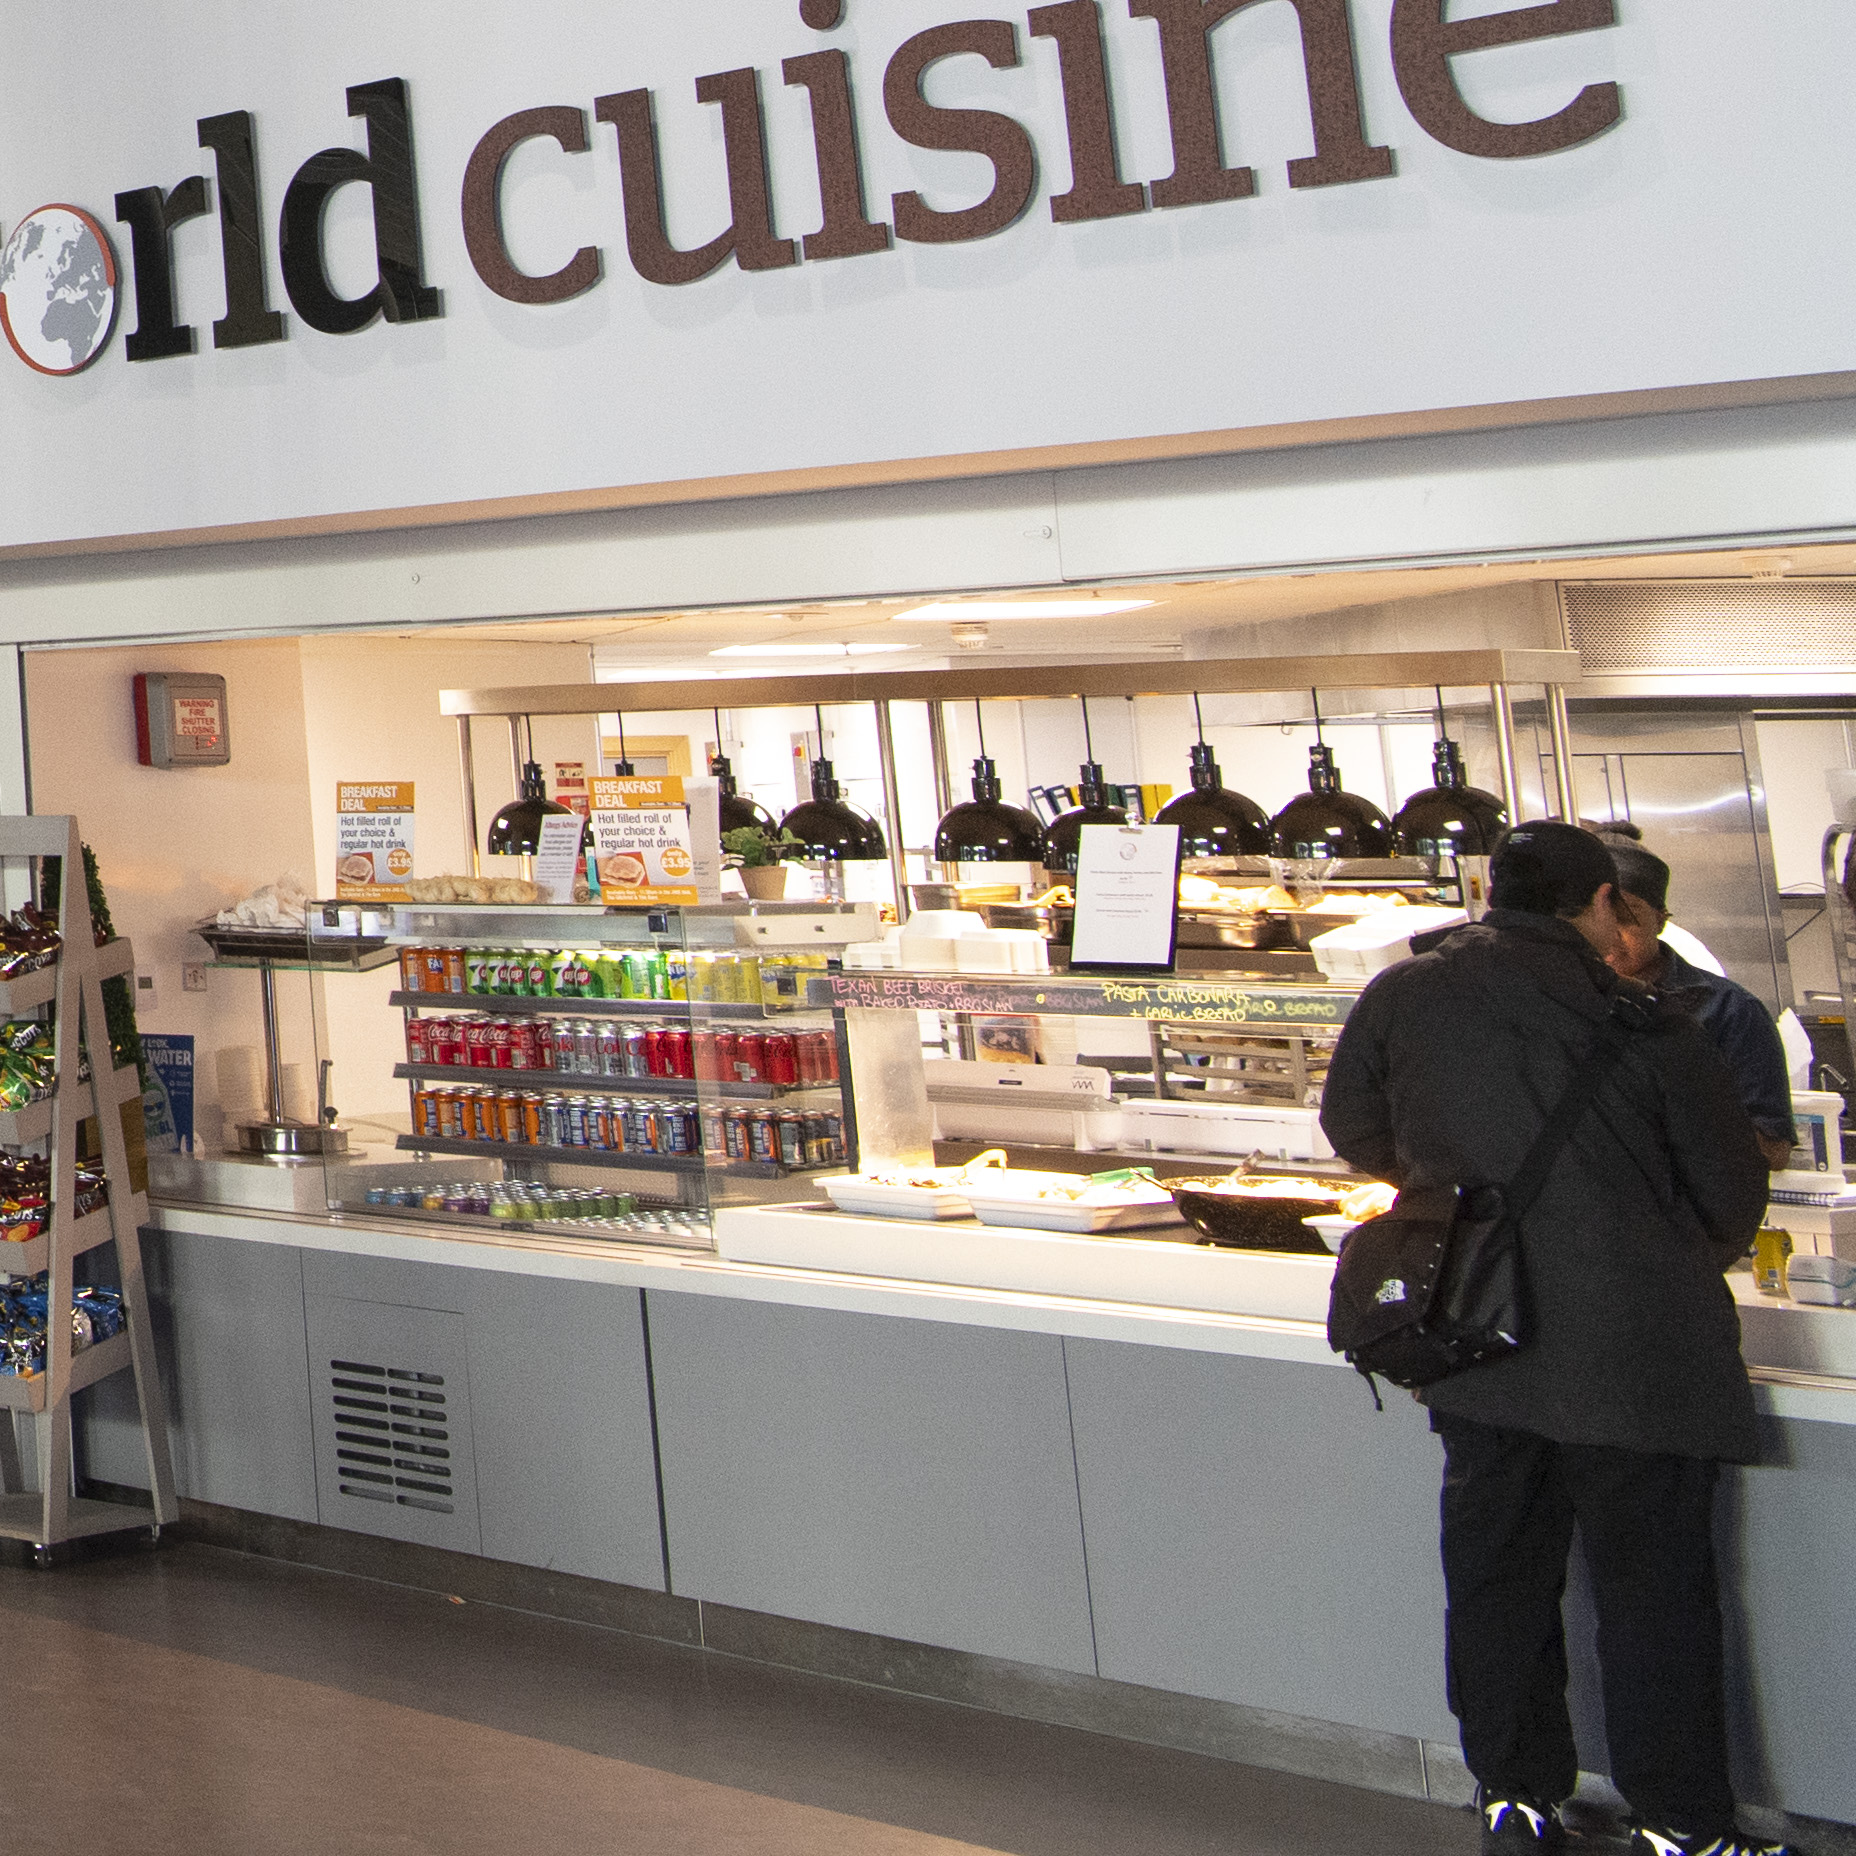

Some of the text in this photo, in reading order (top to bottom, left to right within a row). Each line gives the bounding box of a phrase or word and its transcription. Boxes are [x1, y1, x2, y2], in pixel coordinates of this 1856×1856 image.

[179, 700, 214, 708] WARNING
[181, 717, 215, 725] SHUTTER
[182, 726, 215, 734] CLOSING
[340, 786, 398, 798] BREAKFAST
[593, 781, 663, 794] BREAKFAST
[340, 799, 366, 811] DEAL
[595, 795, 628, 808] DEAL
[340, 816, 402, 826] Hot filled roll of
[598, 813, 672, 824] Hot filled roll of
[340, 829, 396, 839] your choice &
[599, 826, 667, 838] your choice &
[340, 840, 406, 851] regular hot drink
[601, 838, 681, 851] regular hot drink
[666, 850, 683, 858] only
[388, 858, 412, 868] £3.95
[661, 858, 692, 868] £3.95
[824, 975, 966, 995] TEXAN BEEF BRISKET
[1101, 983, 1251, 1005] PASTA CARBONARA
[861, 995, 906, 1010] BAKED
[907, 997, 949, 1011] POTATO
[1192, 1007, 1247, 1022] BREAD
[148, 1049, 192, 1066] WATER
